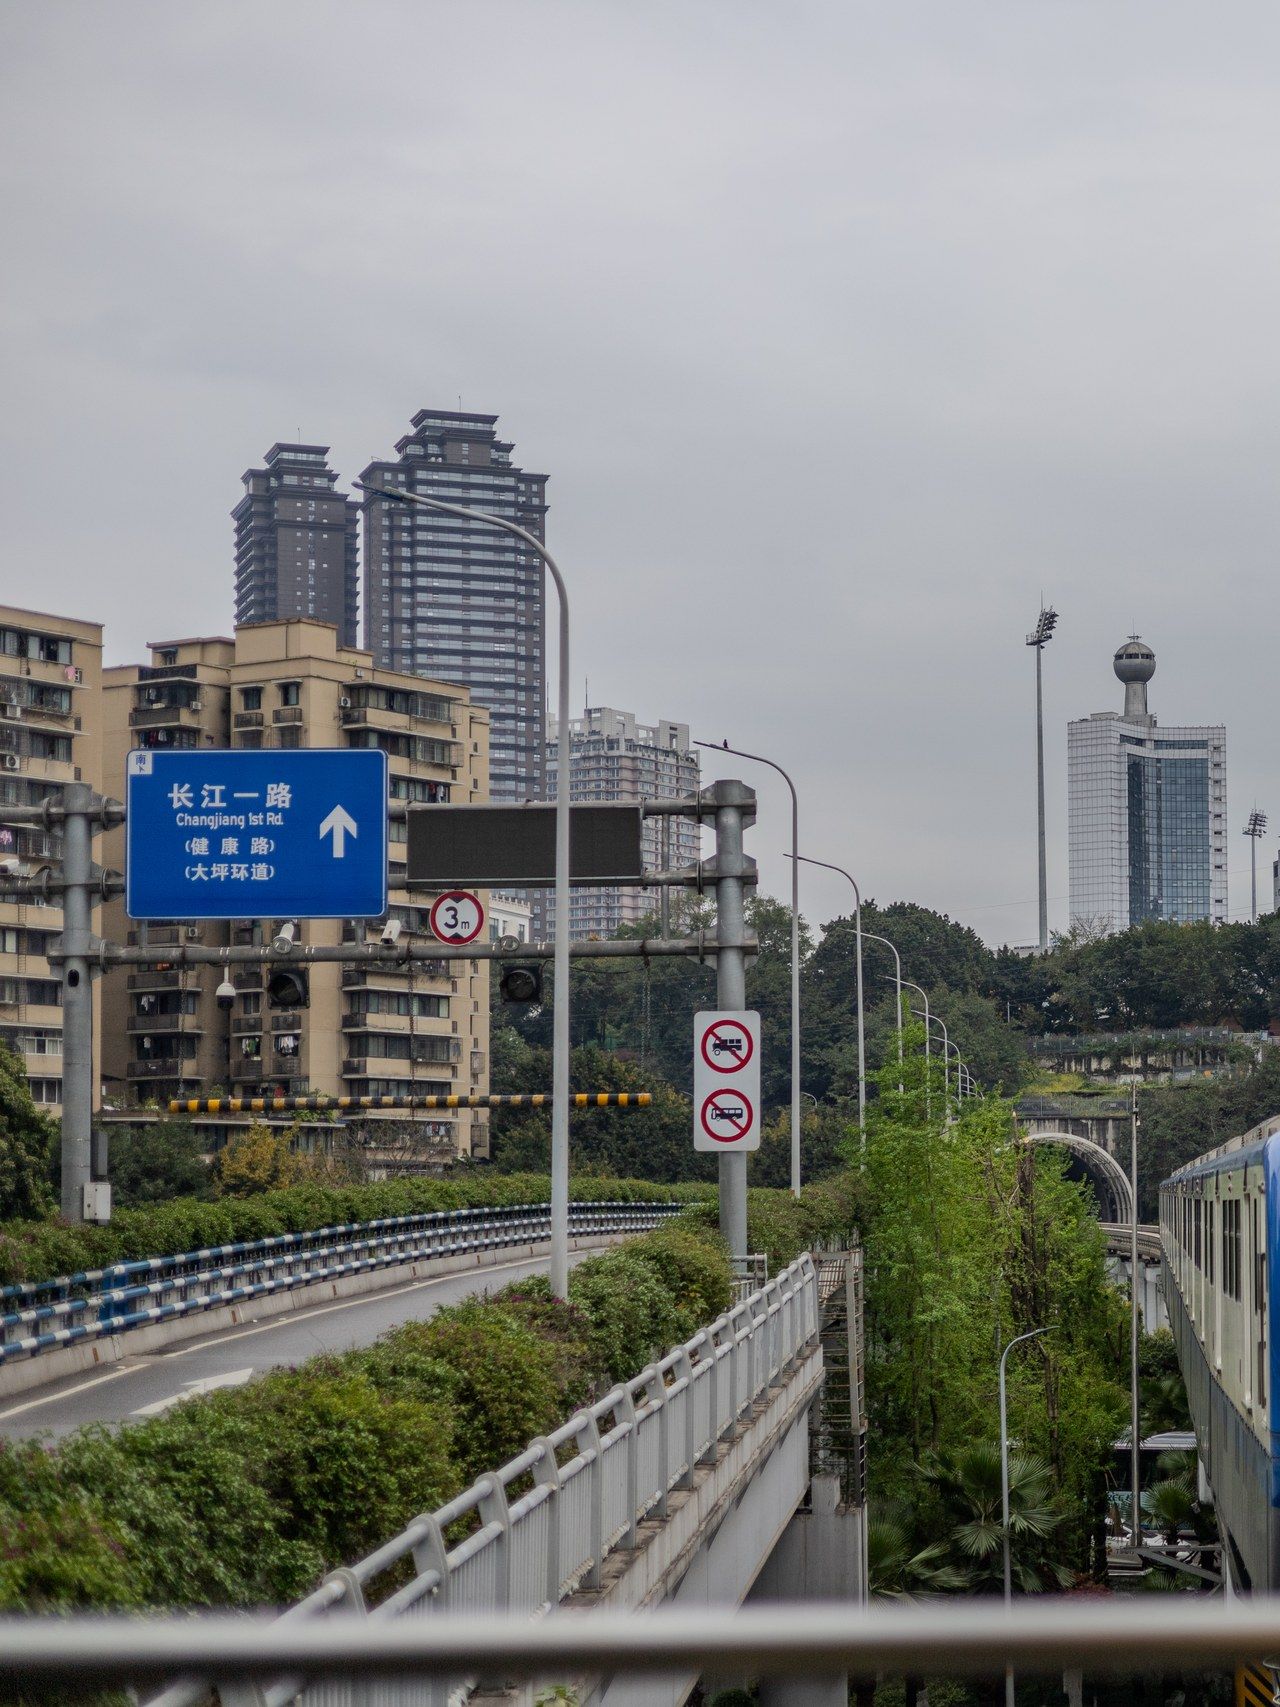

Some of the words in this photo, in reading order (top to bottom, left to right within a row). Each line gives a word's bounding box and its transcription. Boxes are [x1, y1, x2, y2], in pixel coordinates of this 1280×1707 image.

[167, 782, 292, 809] 长江一路
[176, 812, 245, 830] Changjiang
[248, 812, 264, 826] 1st
[266, 812, 284, 826] Rd.
[184, 863, 275, 881] (大坪环道)
